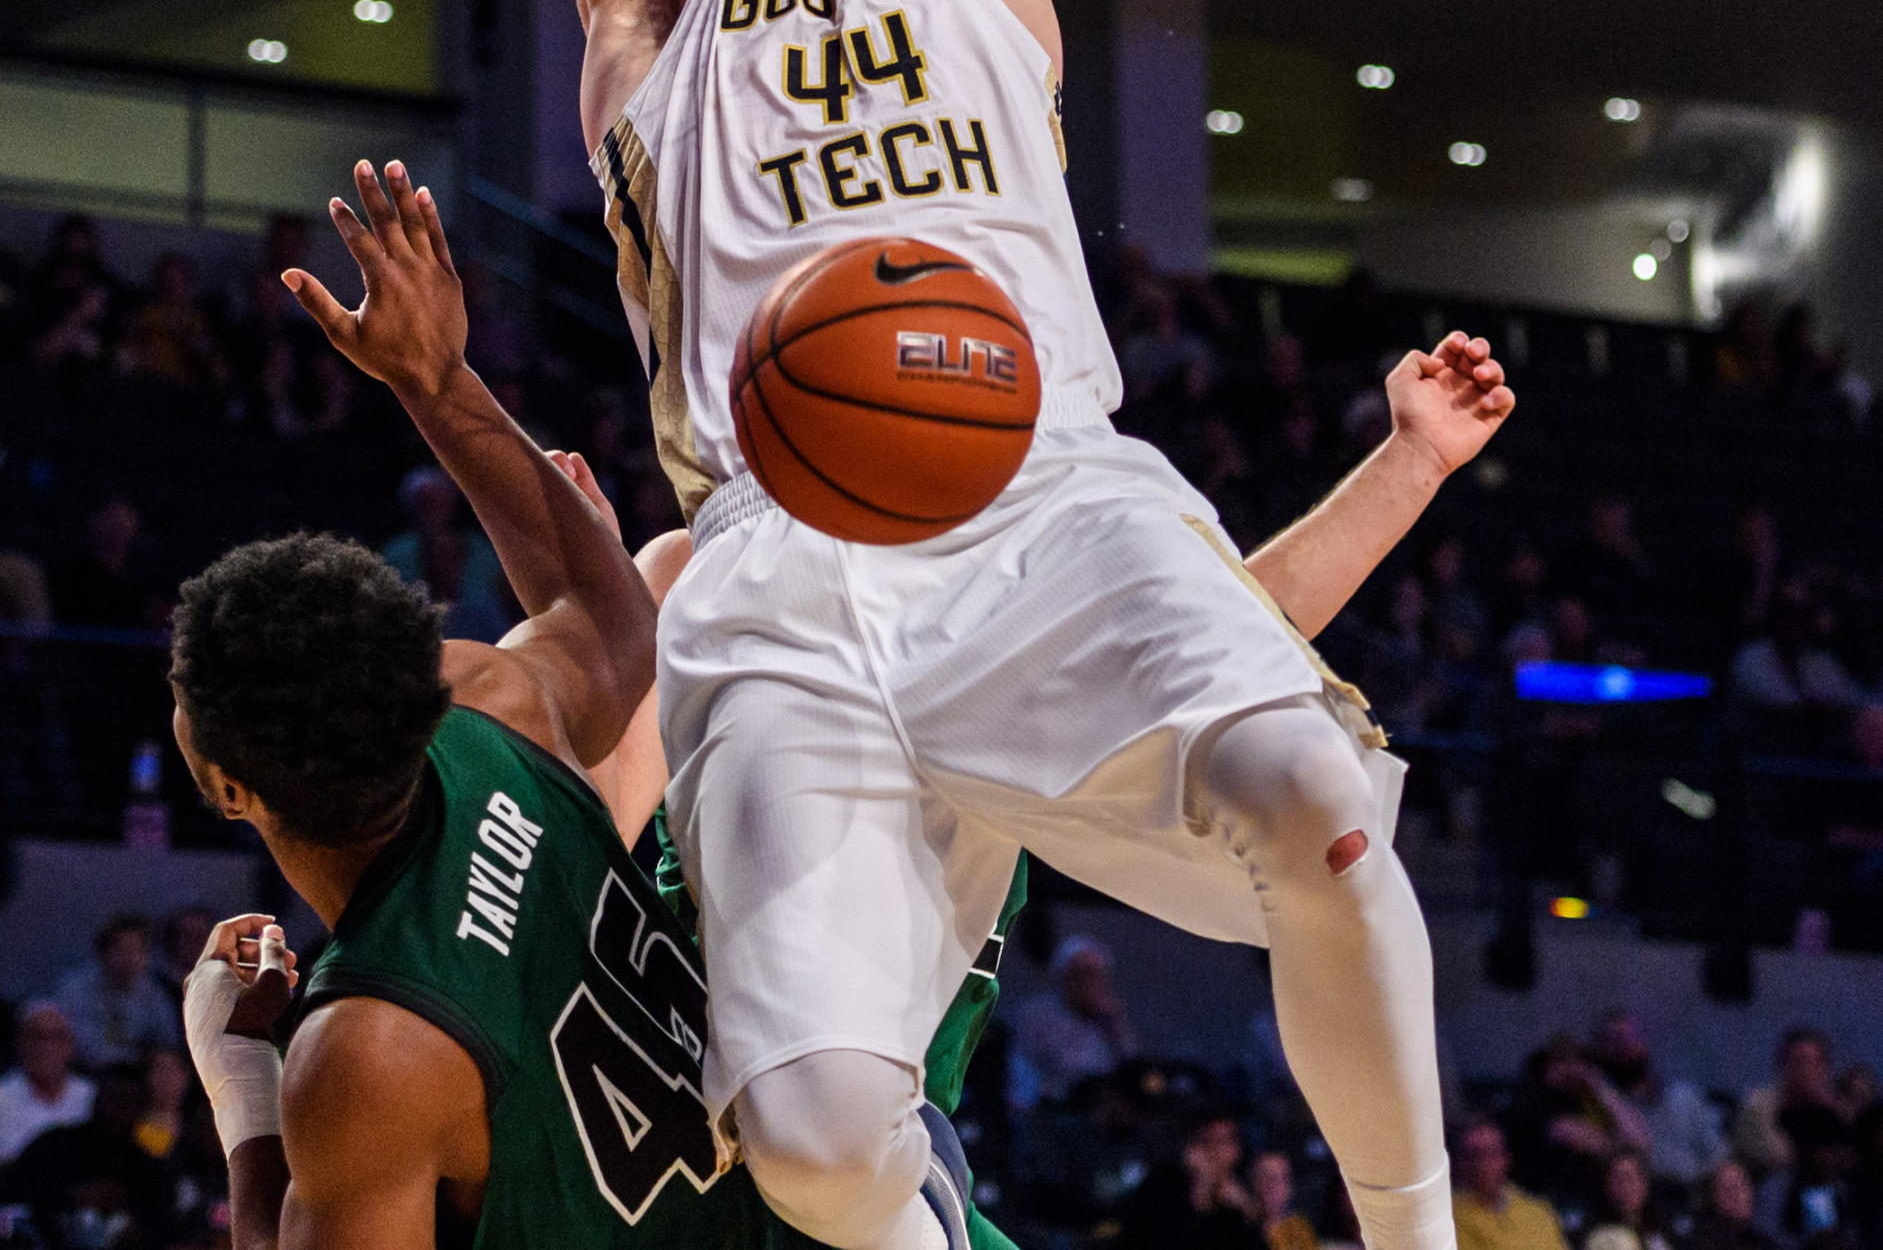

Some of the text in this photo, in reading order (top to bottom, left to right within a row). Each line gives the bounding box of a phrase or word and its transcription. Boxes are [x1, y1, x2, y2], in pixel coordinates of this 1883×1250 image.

[782, 8, 929, 126] 44
[756, 117, 1002, 229] TECH
[896, 330, 1018, 385] ELITE
[455, 790, 545, 958] TAYLOR
